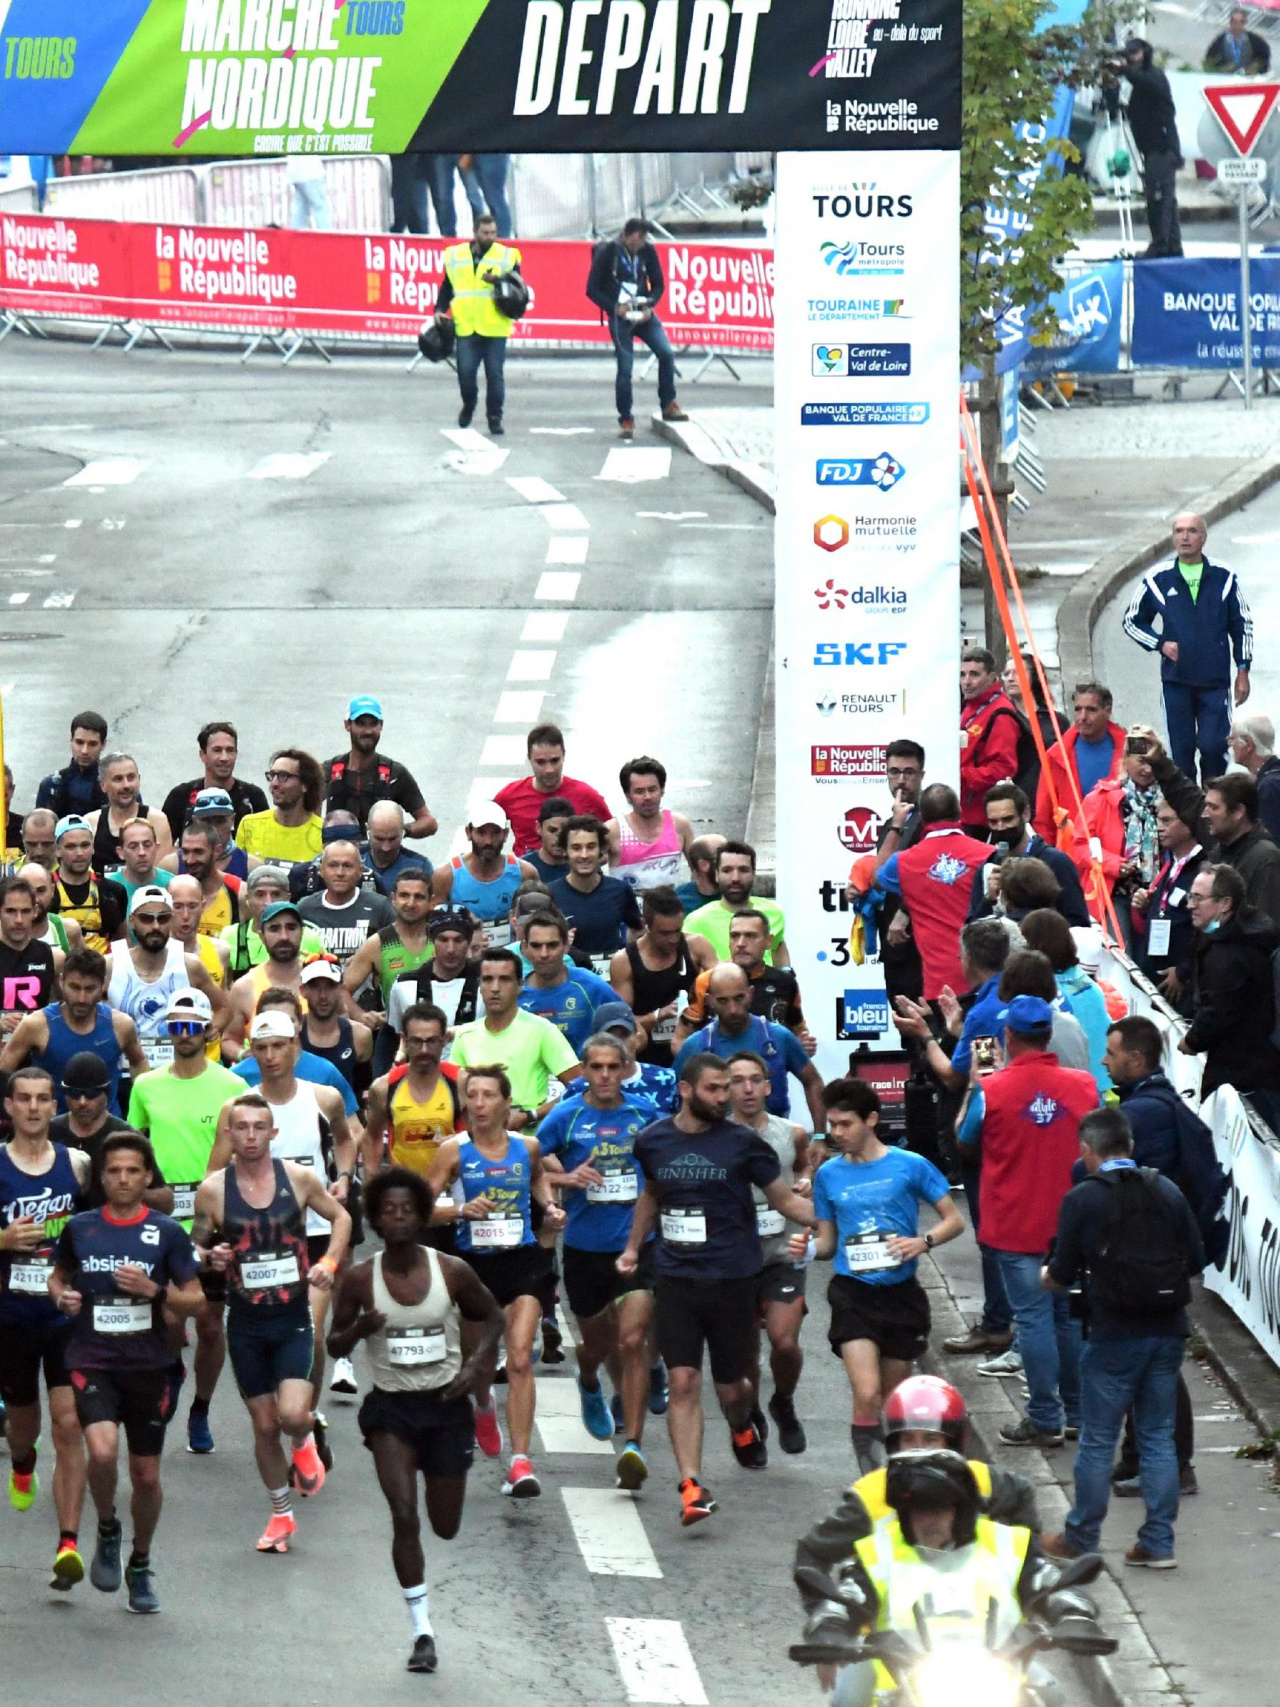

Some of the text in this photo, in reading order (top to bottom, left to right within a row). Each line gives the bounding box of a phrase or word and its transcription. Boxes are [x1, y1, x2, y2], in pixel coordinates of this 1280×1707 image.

[181, 0, 405, 51] MARCHE TOURS
[827, 20, 870, 49] LOIRE
[909, 24, 943, 44] du sport
[5, 37, 77, 80] TOURS
[513, 0, 770, 116] DEPART
[825, 48, 877, 78] VALLEY
[180, 57, 382, 134] NORDIQUE
[826, 99, 918, 117] la Nouvelle
[845, 116, 939, 134] République
[253, 134, 282, 152] CROIRE
[285, 134, 303, 153] QUE
[331, 133, 373, 152] POSSIBLE
[812, 194, 913, 218] TOURS
[3, 217, 78, 253] Nouvelle
[156, 227, 269, 265] la Nouvelle
[857, 242, 905, 256] Tours
[364, 238, 446, 275] la Nouv
[5, 248, 100, 291] République
[669, 247, 774, 288] Nouvelle
[180, 260, 297, 303] République
[670, 281, 774, 322] Républi
[807, 299, 880, 312] TOURAINE
[1164, 293, 1237, 311] BANQUE
[1208, 312, 1240, 331] VAL
[850, 361, 907, 372] Val de Loire
[805, 405, 908, 415] BANQUE POPULAIRE
[832, 413, 908, 422] VAL DE FRANCE
[820, 462, 863, 481] FDJ
[855, 515, 917, 526] Harmonie
[855, 525, 917, 536] mutuelle
[851, 586, 907, 604] dalkia
[813, 643, 907, 665] SKF
[842, 694, 898, 703] RENAULT
[842, 703, 884, 713] TOURS
[815, 747, 887, 761] la Nouvelle
[830, 759, 888, 775] Républiq
[831, 938, 850, 967] 3
[863, 1001, 887, 1010] france
[846, 1006, 887, 1024] bleu
[1035, 1113, 1053, 1124] 37
[657, 1167, 728, 1180] FINISHER
[589, 1184, 621, 1194] 42122
[2, 1186, 74, 1224] Vegan
[474, 1228, 505, 1238] 42015
[850, 1250, 880, 1262] 42301
[13, 1272, 46, 1284] 42113
[245, 1268, 278, 1280] 42007
[97, 1314, 131, 1324] 42005
[390, 1345, 425, 1356] 47793
